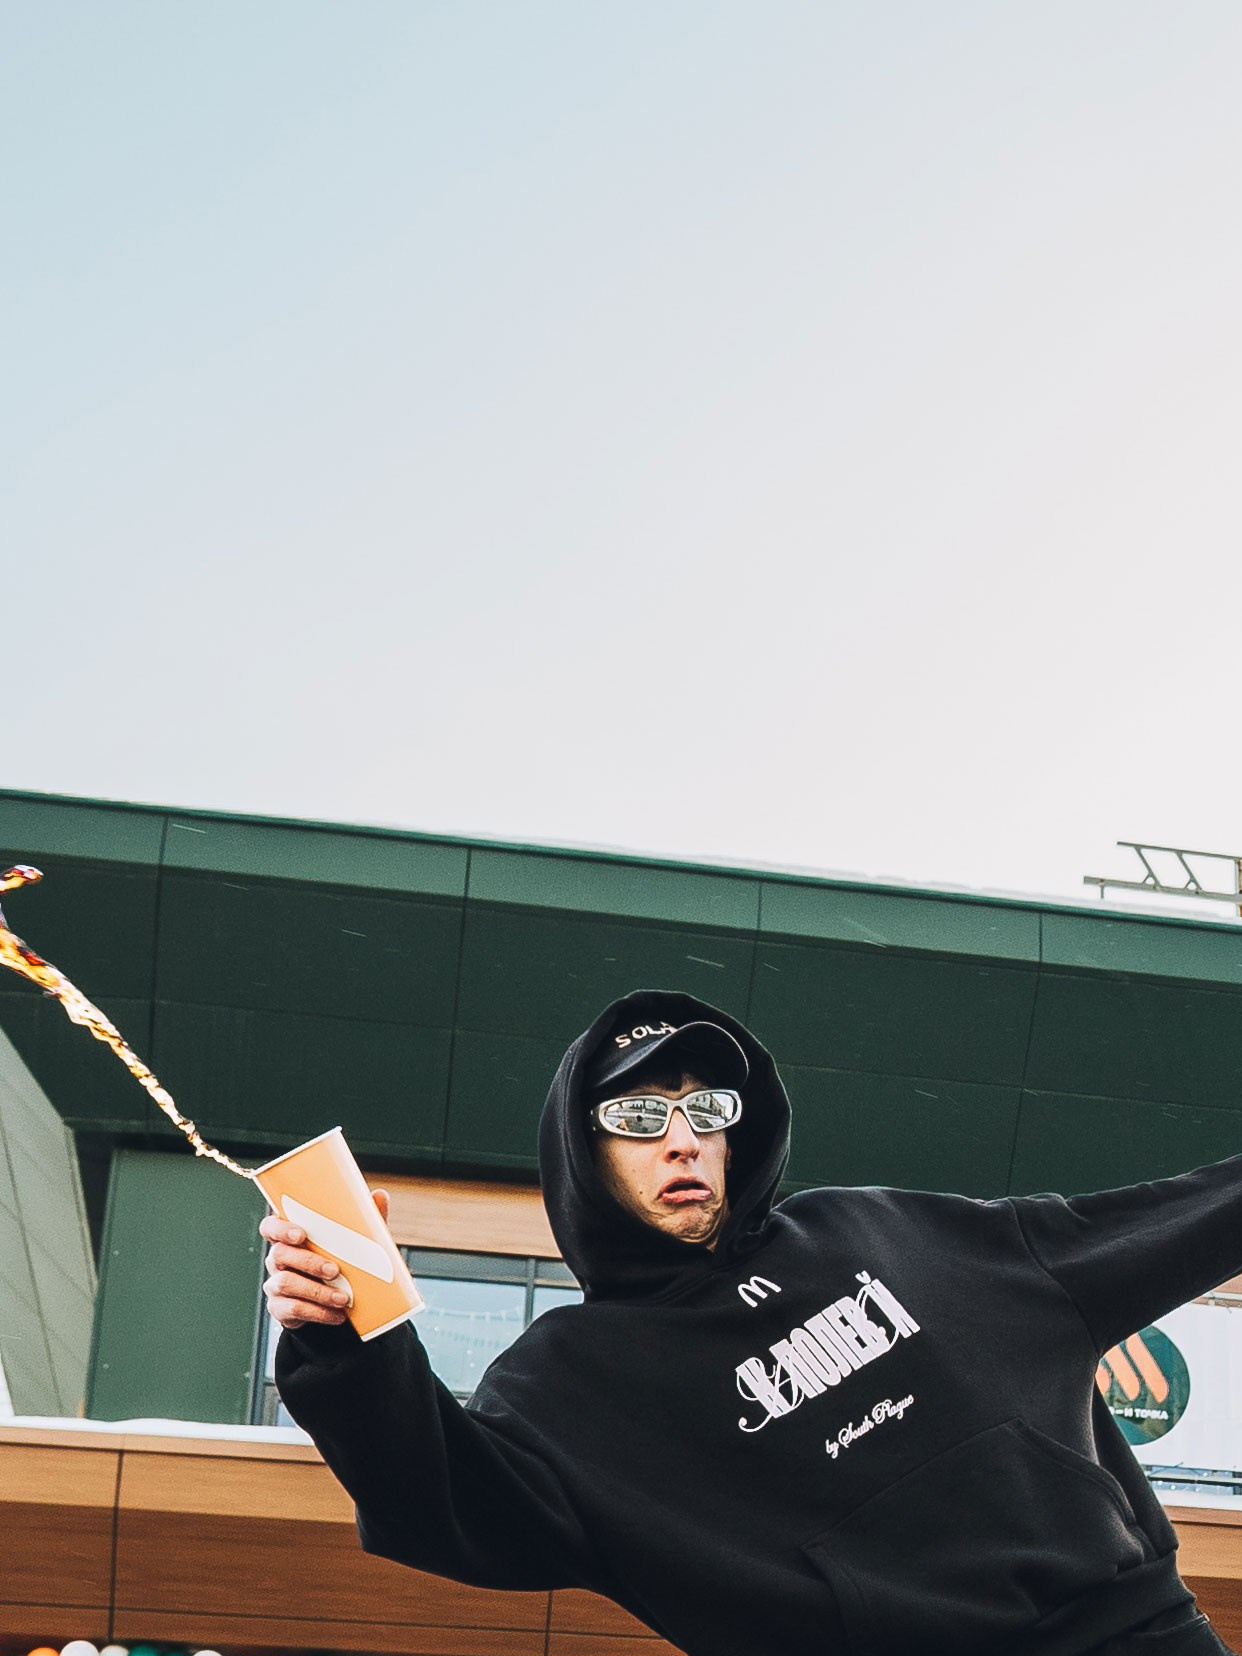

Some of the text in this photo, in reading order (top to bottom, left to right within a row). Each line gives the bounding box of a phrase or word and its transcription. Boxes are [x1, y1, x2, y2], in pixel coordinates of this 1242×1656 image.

[825, 1394, 914, 1459] by South Plague
